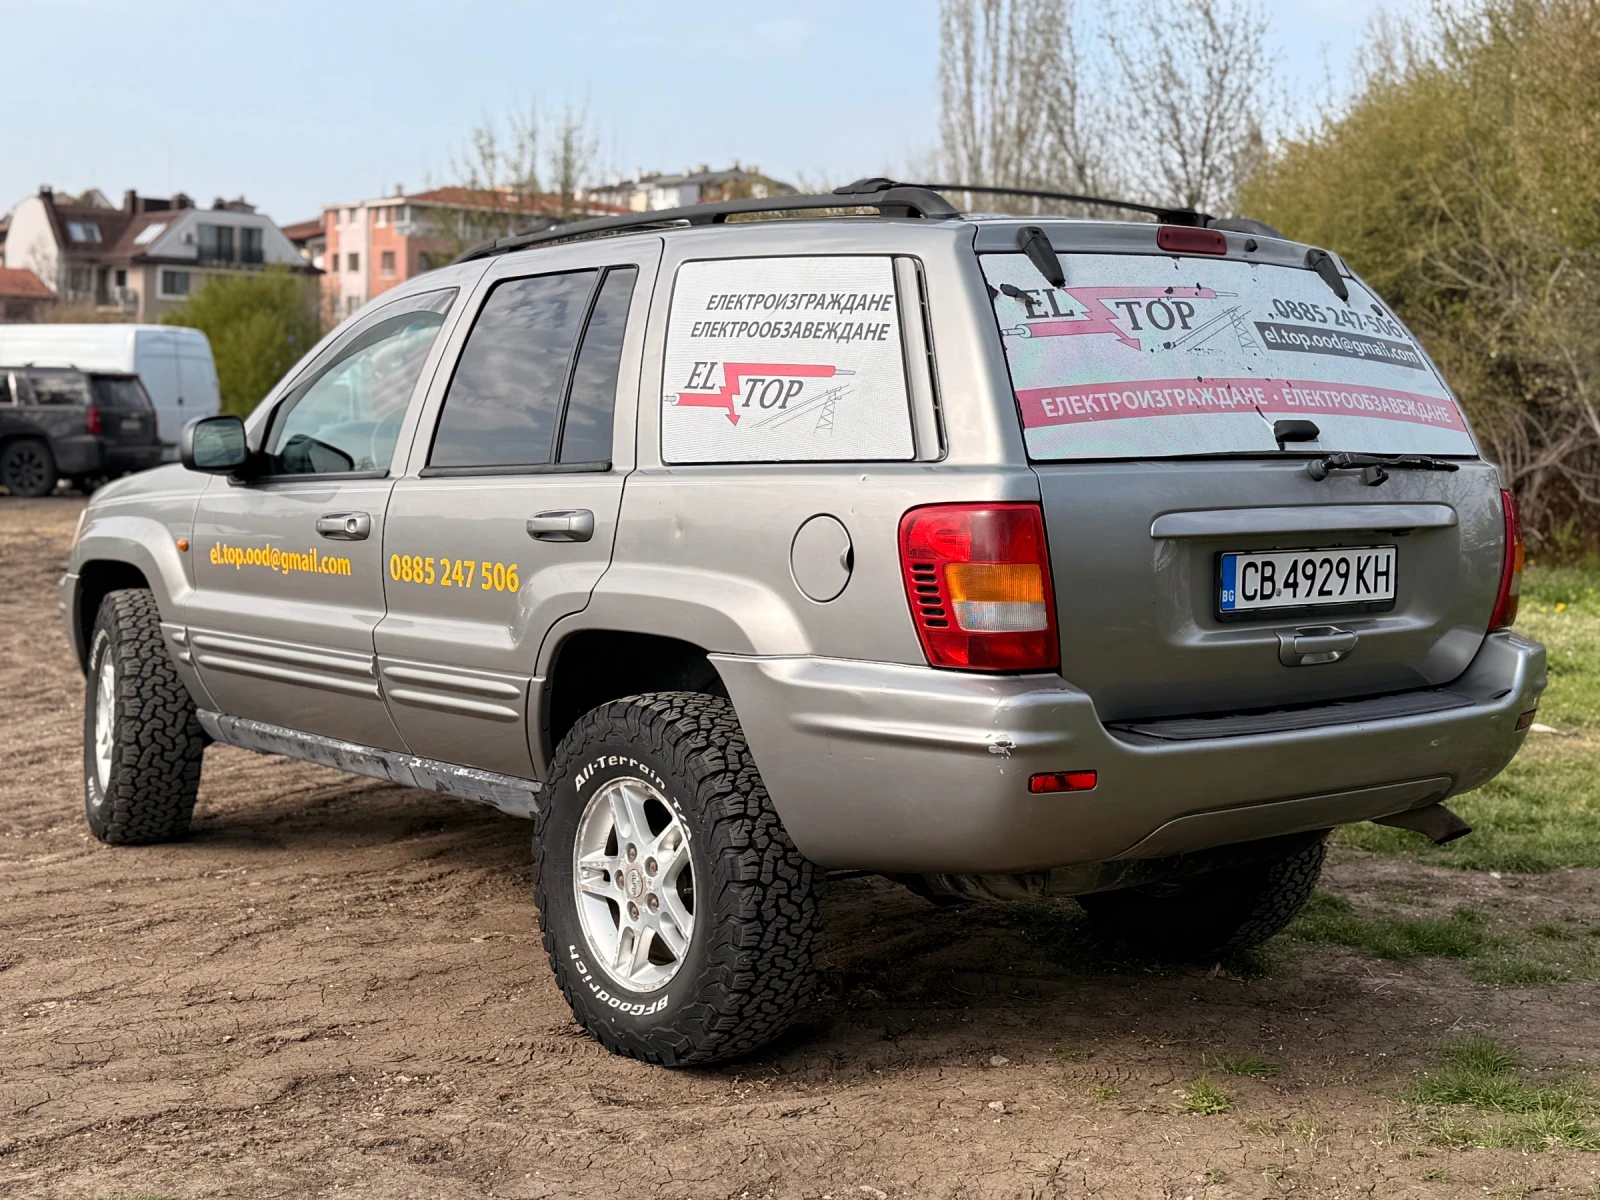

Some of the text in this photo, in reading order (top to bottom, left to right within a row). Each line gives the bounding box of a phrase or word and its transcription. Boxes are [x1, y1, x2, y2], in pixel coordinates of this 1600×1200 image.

[706, 294, 894, 314] ЕЛЕКТРОИЗГРАЖДАНЕ
[1021, 288, 1195, 331] EL TOP
[1272, 299, 1403, 338] 0885 247 506
[690, 321, 890, 344] ЕЛЕКТРООБЗАВЕЖДАНЕ
[1264, 326, 1419, 363] el.top.ood@gmail.com
[684, 361, 803, 410] EL TOP
[1041, 387, 1452, 423] ЕЛЕКТРОИЗГРАЖДАНЕ ЕЛЕКТРООБЗАВЕЖДАНЕ
[210, 541, 351, 576] el.top.ood@gmail.com
[390, 554, 519, 593] 0885 247 506
[1241, 554, 1391, 601] CB 4929 KH
[1222, 590, 1235, 603] BG
[573, 755, 666, 792] All-Terrain
[568, 944, 669, 1016] BFGoodrich
